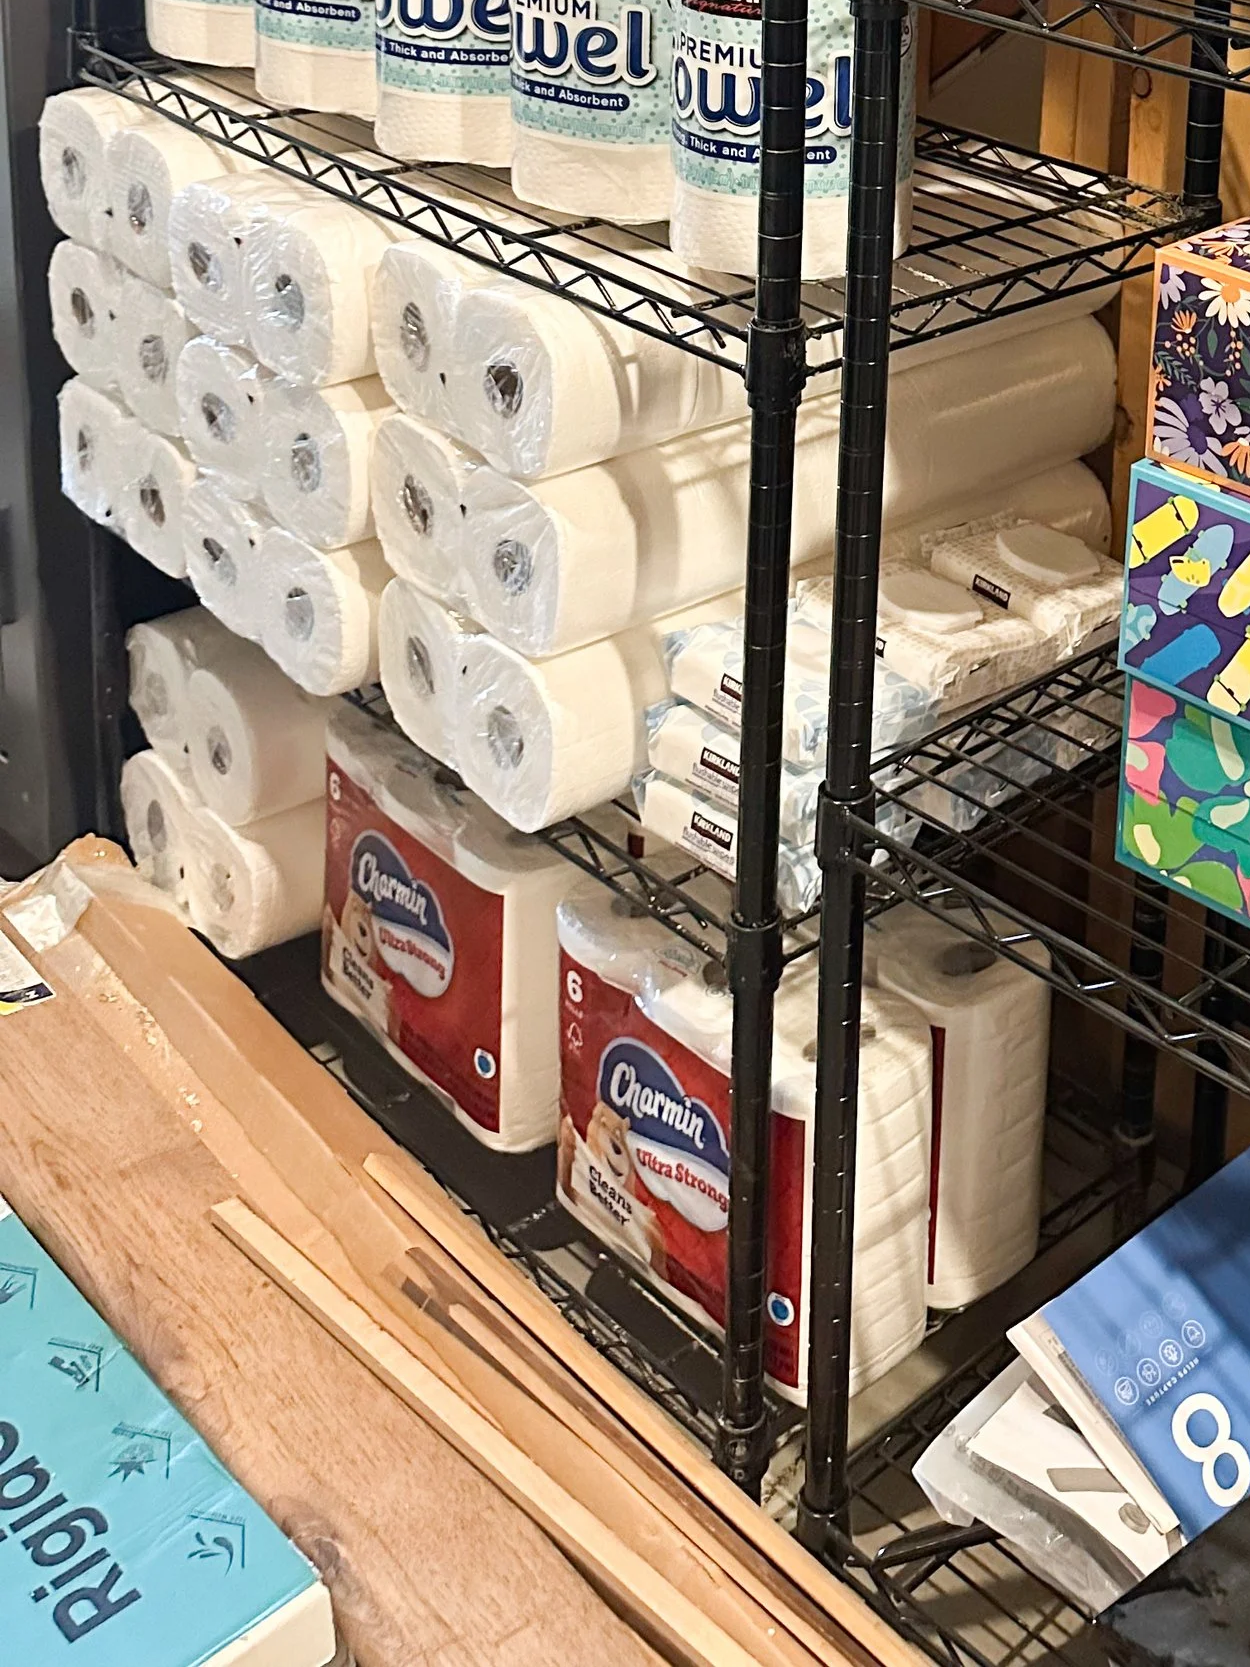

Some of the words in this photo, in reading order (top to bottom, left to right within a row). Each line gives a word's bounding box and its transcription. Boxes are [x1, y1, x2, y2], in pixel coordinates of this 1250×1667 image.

[273, 0, 293, 13] and
[295, 2, 358, 20] Absorbent
[390, 41, 418, 58] Thick
[420, 48, 445, 61] and
[534, 84, 556, 99] and
[558, 86, 624, 108] Absorbent
[689, 136, 717, 156] Thick
[721, 145, 748, 159] and
[974, 575, 1011, 605] KIRKLAND
[329, 771, 342, 801] 6
[693, 814, 732, 844] KIRKLAND
[357, 851, 428, 926] Charmin
[566, 969, 584, 1004] 6
[609, 1060, 706, 1150] Charmin
[587, 1165, 633, 1215] Cleans
[635, 1147, 675, 1181] Ultra
[674, 1164, 730, 1214] Strong
[589, 1183, 631, 1228] Better
